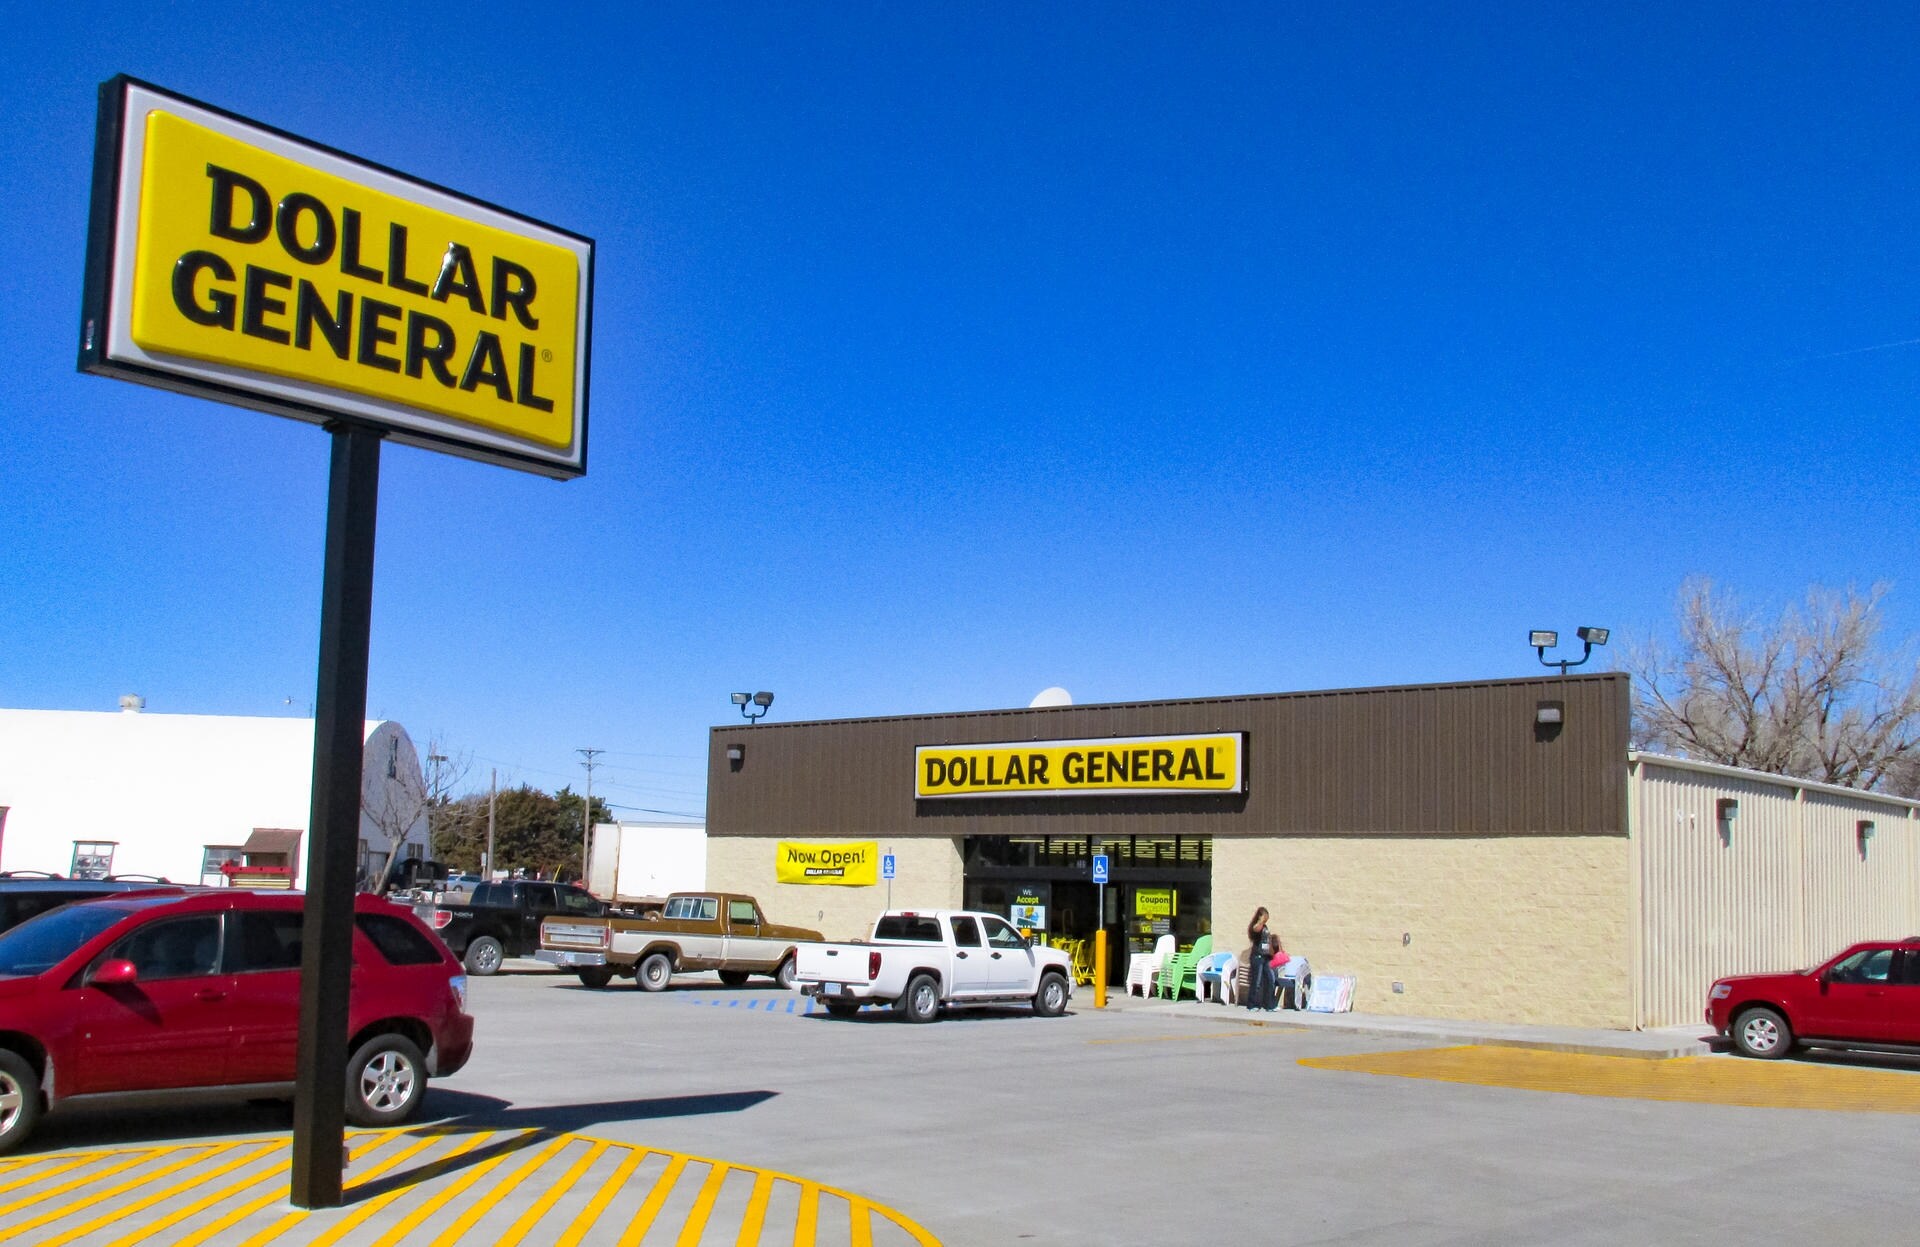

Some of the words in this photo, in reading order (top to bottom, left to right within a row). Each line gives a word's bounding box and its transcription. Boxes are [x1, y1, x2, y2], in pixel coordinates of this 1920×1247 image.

[206, 162, 540, 330] DOLLAR
[171, 249, 554, 413] GENERAL
[925, 754, 1050, 787] DOLLAR
[1062, 747, 1226, 784] GENERAL
[787, 849, 816, 863] Now
[820, 849, 865, 867] Open!
[1016, 895, 1039, 905] Accept
